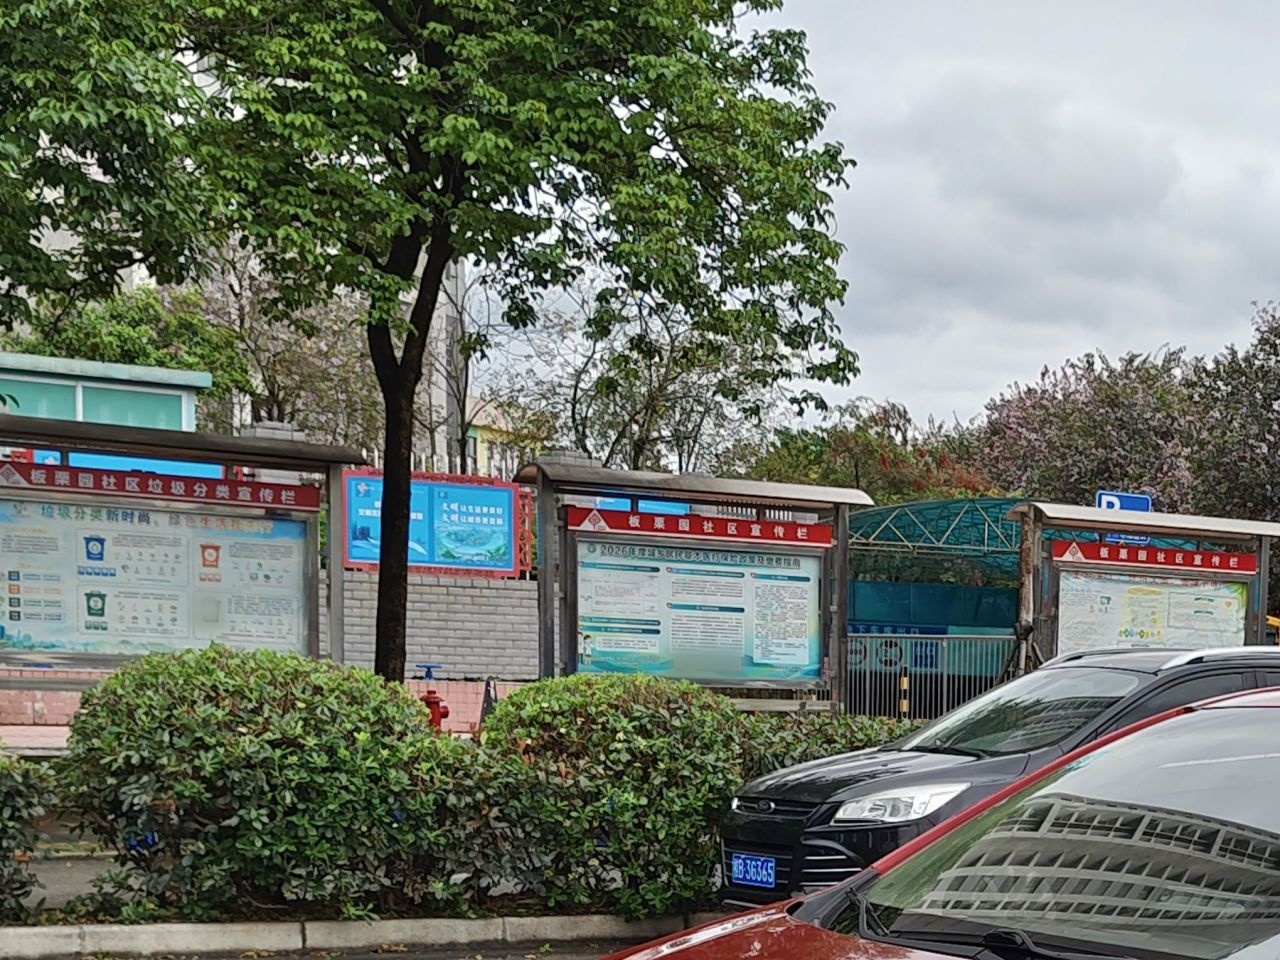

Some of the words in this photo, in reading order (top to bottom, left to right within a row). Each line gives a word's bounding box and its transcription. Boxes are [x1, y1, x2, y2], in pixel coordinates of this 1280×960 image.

[30, 468, 297, 505] 板栗园社区垃圾分类宣传栏
[628, 514, 809, 540] 板栗园社区宣传栏
[1101, 547, 1238, 568] 板栗园社区宣传栏
